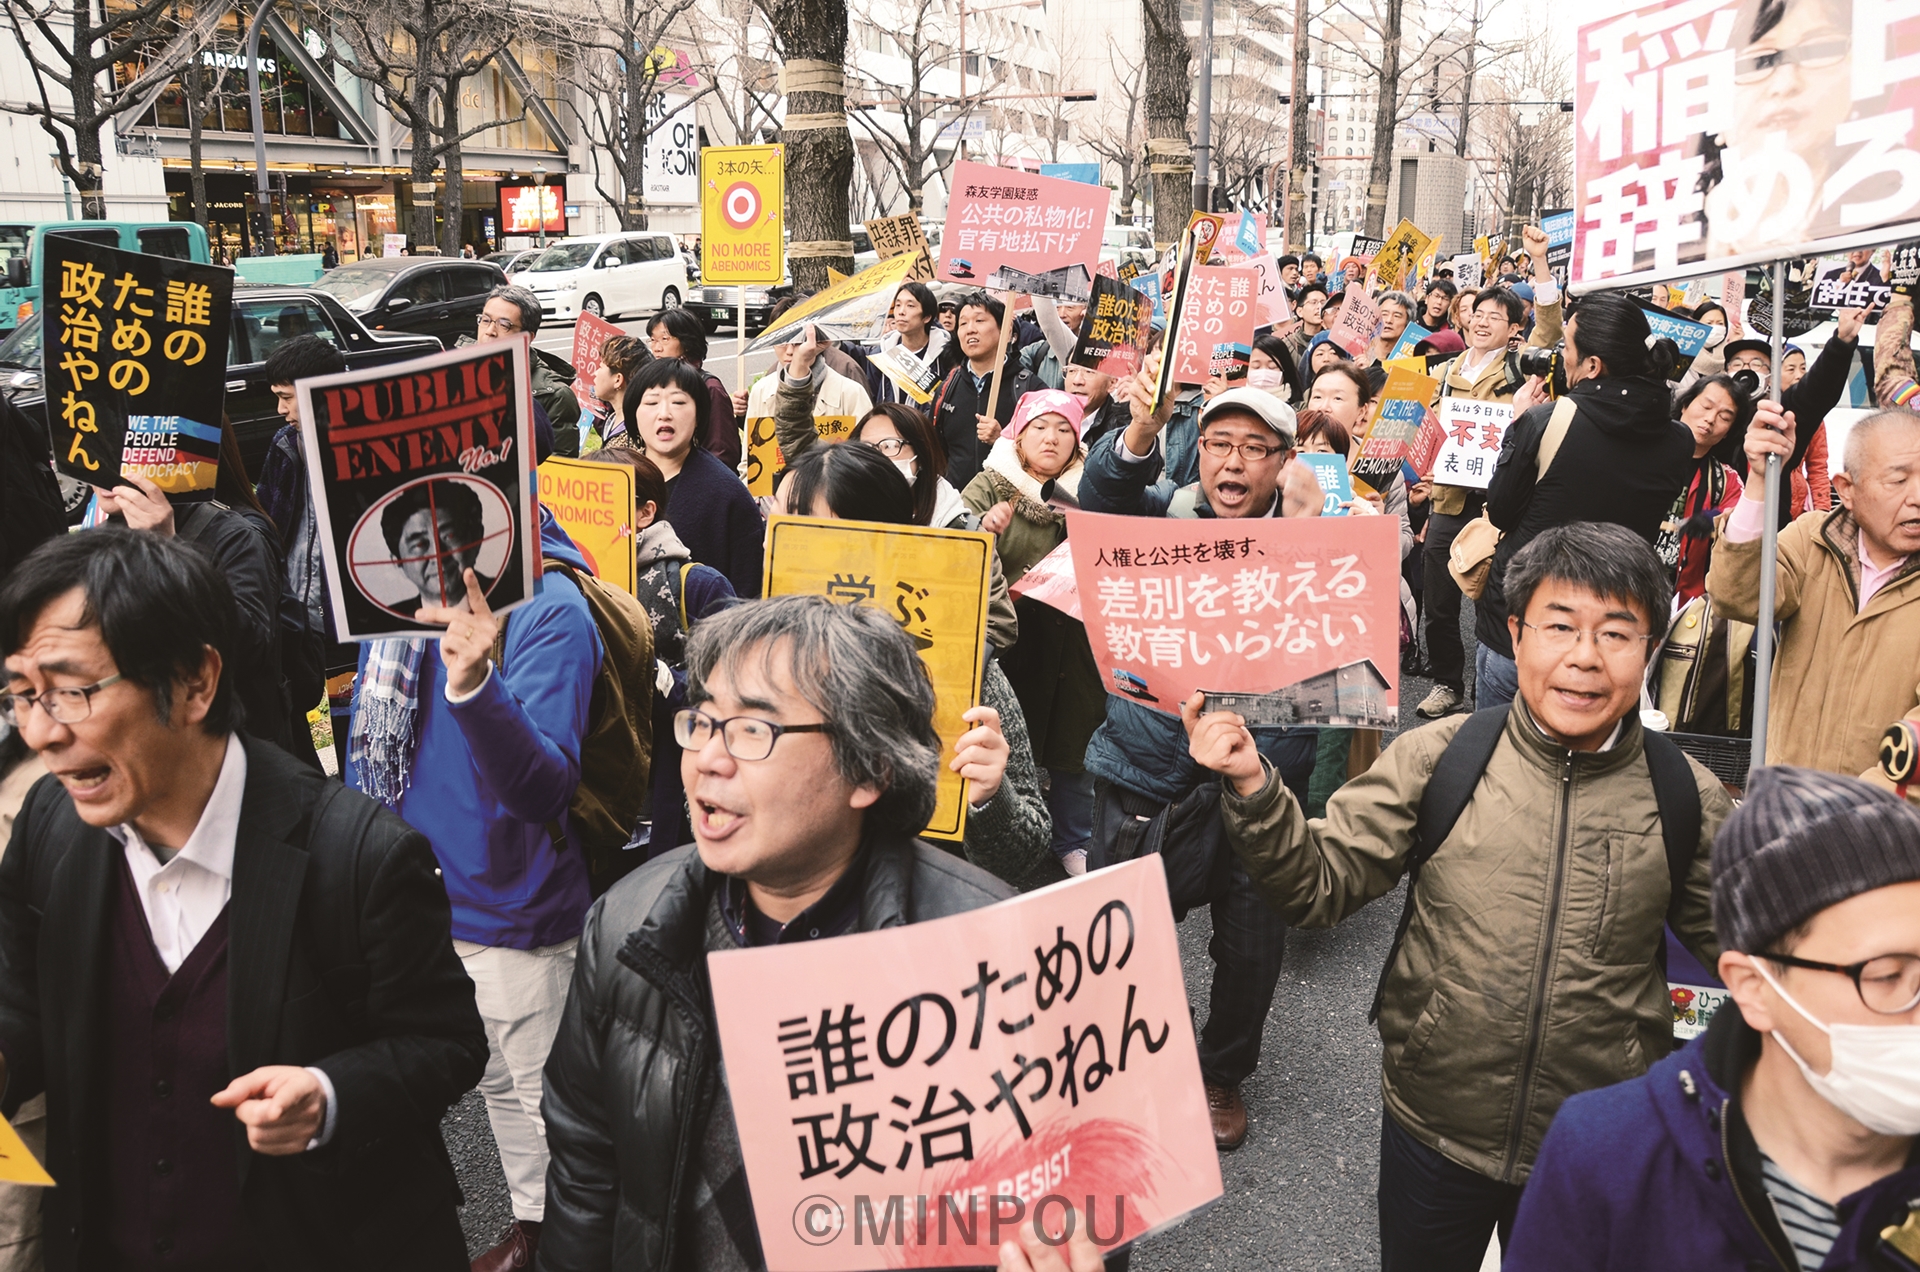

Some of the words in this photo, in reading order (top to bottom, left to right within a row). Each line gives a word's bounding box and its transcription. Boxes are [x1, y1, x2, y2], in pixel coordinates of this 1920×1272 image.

[672, 122, 694, 148] OF
[965, 185, 1039, 201] 森友学園疑惑
[310, 203, 337, 212] OPA
[869, 215, 921, 248] 共謀罪
[958, 228, 1081, 254] 官有地払下げ
[711, 243, 730, 257] NO
[733, 243, 771, 257] MORE
[1353, 247, 1363, 255] WE
[711, 260, 771, 272] ABENOMICS
[1204, 276, 1226, 335] ための
[1228, 277, 1250, 318] 誰の
[1817, 278, 1891, 307] 辞任で
[108, 272, 154, 396] ための
[164, 280, 212, 366] 誰の
[1646, 314, 1706, 340] 防衛大臣の
[1084, 347, 1094, 355] WE
[1211, 349, 1235, 359] PEOPLE
[1213, 343, 1223, 352] WE
[1223, 342, 1235, 351] THE
[59, 260, 106, 472] 政治やねん
[324, 355, 506, 427] PUBLIC
[1382, 399, 1397, 417] WE
[1398, 400, 1418, 417] THE
[128, 415, 149, 431] WE
[153, 415, 180, 431] THE
[1372, 420, 1409, 436] PEOPLE
[124, 431, 179, 447] PEOPLE
[331, 408, 507, 481] ENEMY
[1361, 438, 1402, 455] DEFEND
[1415, 424, 1435, 469] RIGHTS
[122, 447, 176, 462] DEFEND
[458, 437, 513, 474] No.1
[120, 461, 201, 478] DEMOCRACY
[538, 473, 552, 496] O
[557, 477, 614, 504] MORE
[1097, 554, 1367, 620] 差別を教える
[1105, 613, 1368, 668] 教育いらない
[777, 899, 1135, 1100] 誰のための
[792, 984, 1170, 1181] 政治やねん
[945, 1185, 988, 1216] WE
[997, 1144, 1072, 1211] RESIST
